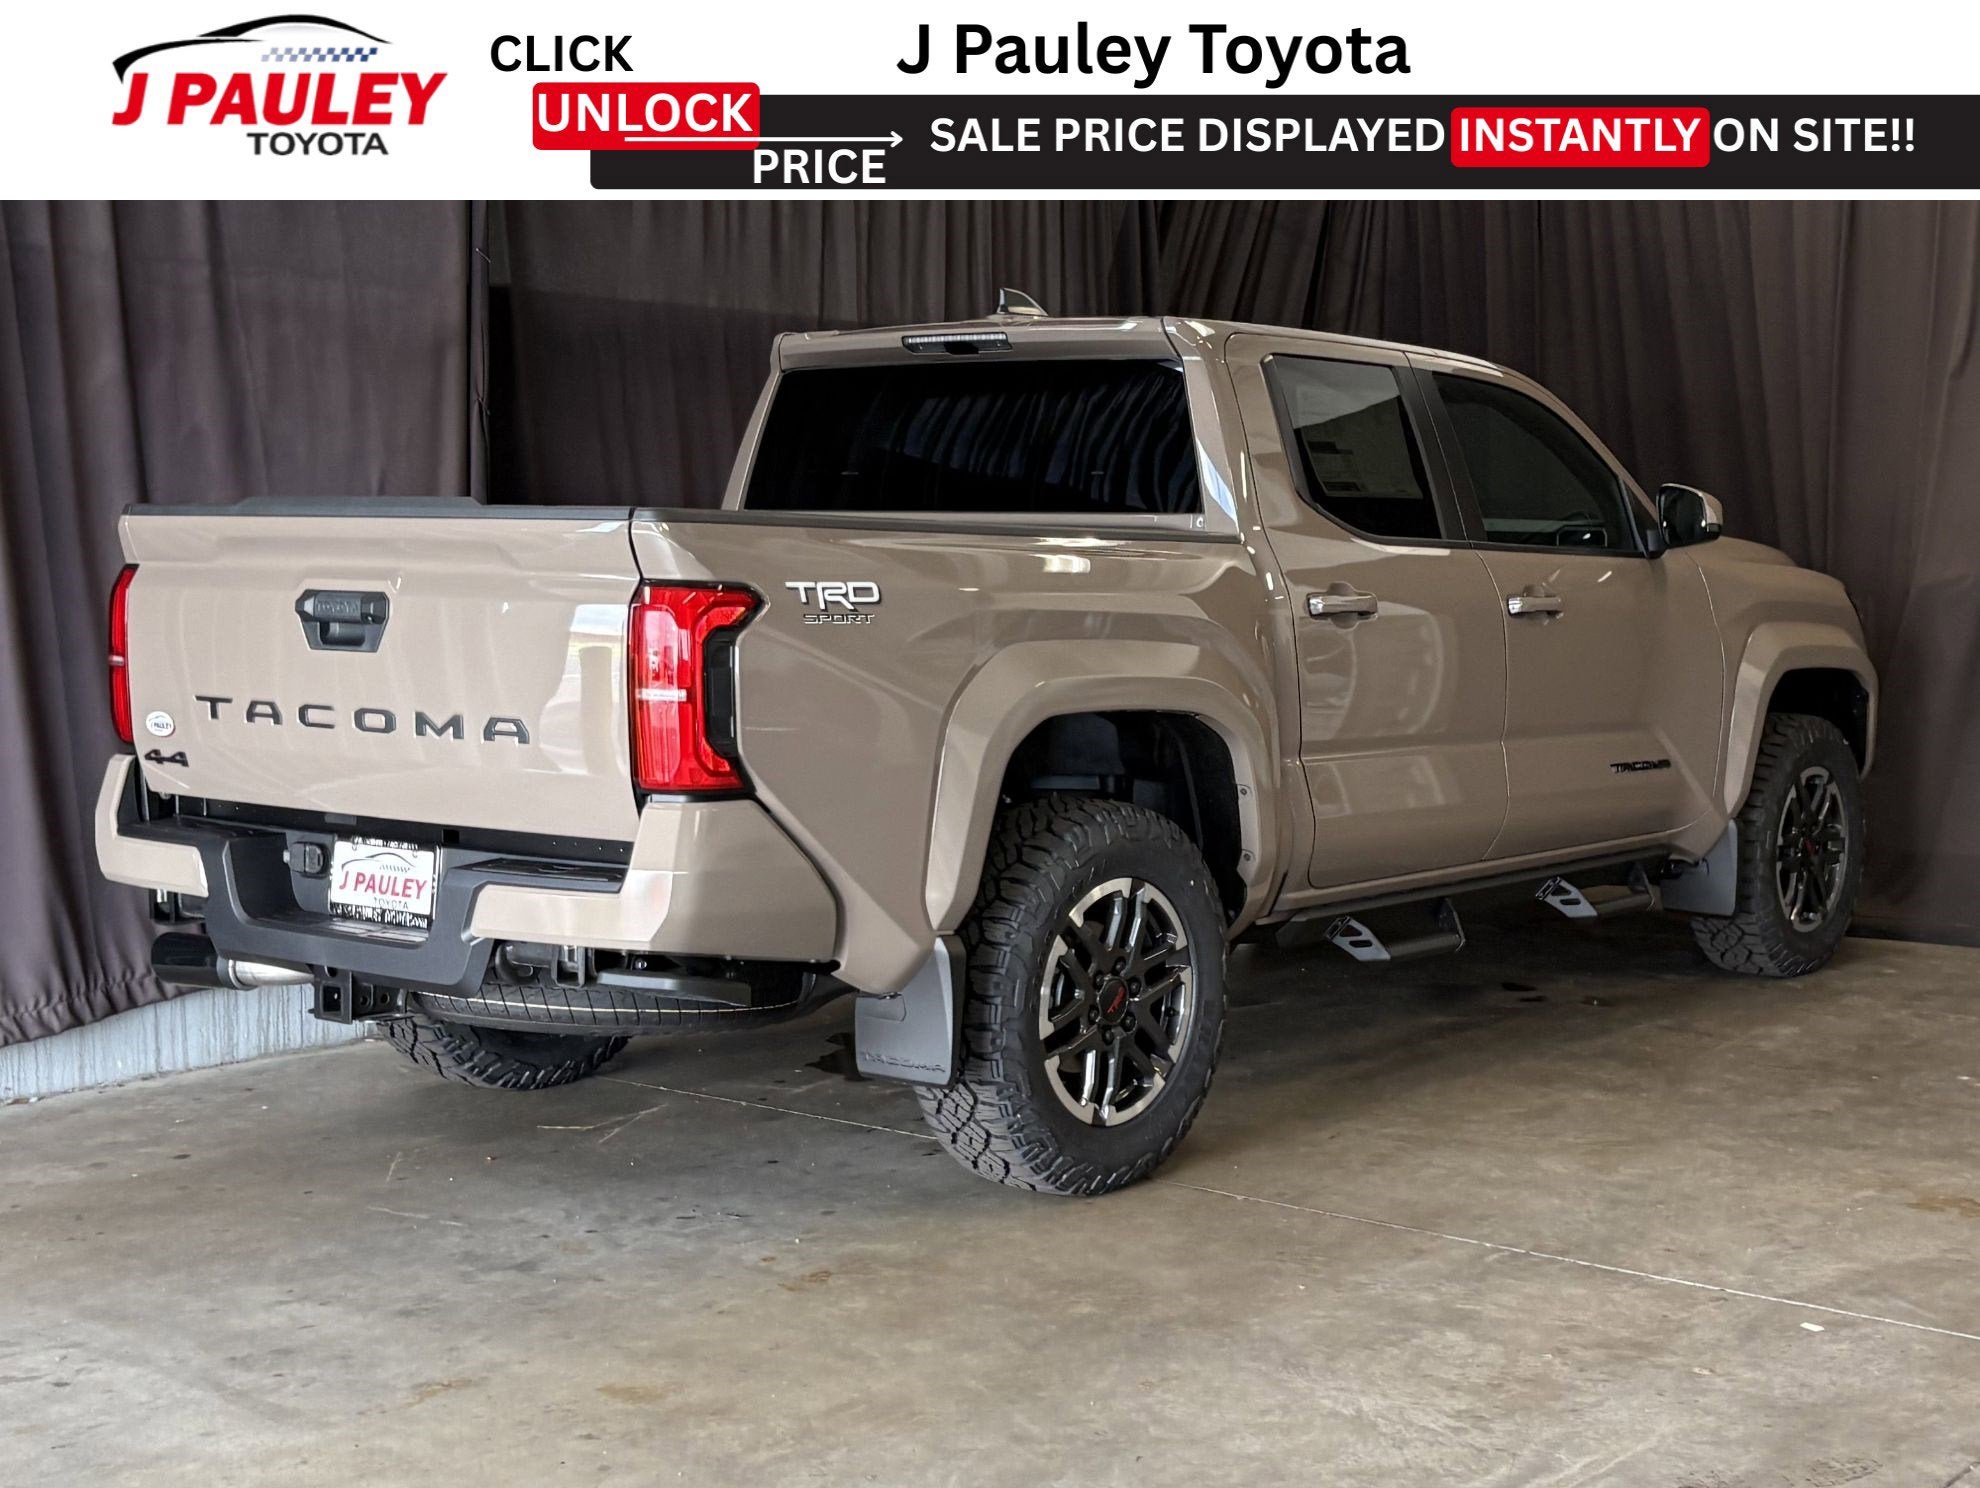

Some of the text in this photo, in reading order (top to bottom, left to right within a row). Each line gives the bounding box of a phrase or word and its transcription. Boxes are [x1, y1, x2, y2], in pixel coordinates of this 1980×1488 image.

[784, 581, 882, 612] TRD
[803, 613, 876, 625] SPORT
[194, 694, 531, 744] TACOMA
[339, 870, 428, 900] J PAULEY
[373, 896, 409, 910] TOYOTA
